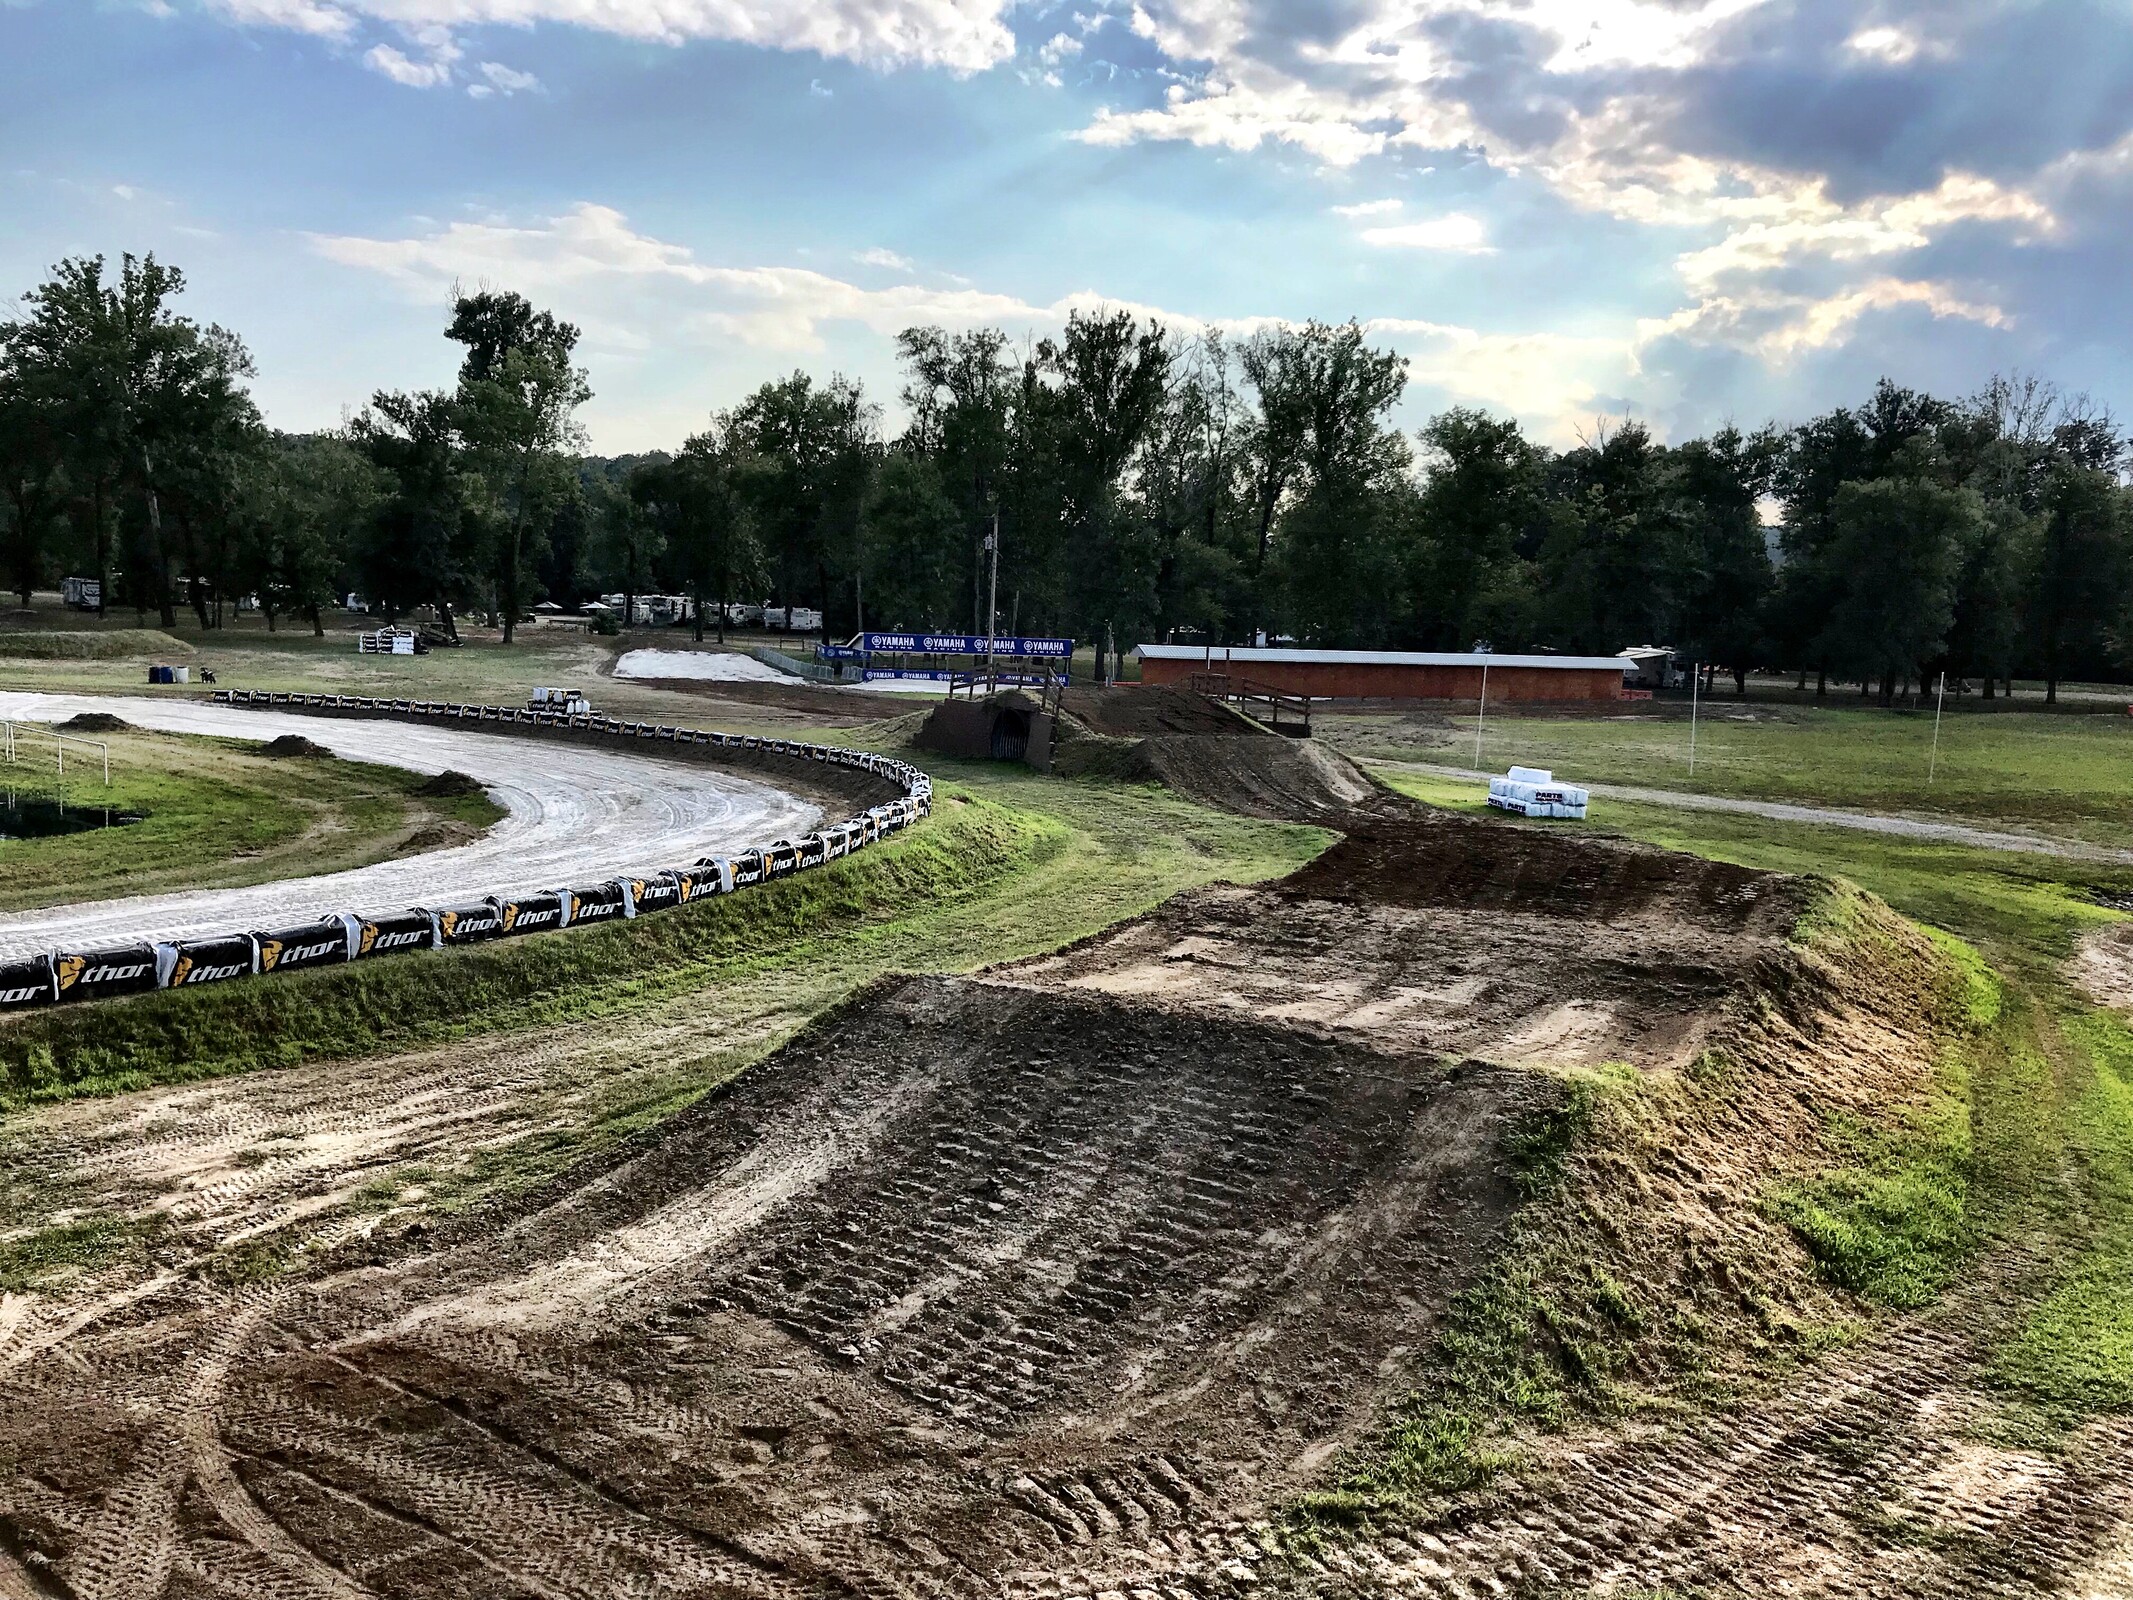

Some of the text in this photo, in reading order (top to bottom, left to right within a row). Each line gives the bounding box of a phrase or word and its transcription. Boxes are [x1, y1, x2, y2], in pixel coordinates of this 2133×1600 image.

[882, 636, 1064, 651] YAMAHA YAMAHA YMAHA YAMAHA
[773, 856, 795, 872] thor
[802, 852, 824, 868] thor
[736, 869, 761, 884] thor
[644, 884, 677, 899] thor
[691, 878, 721, 897] thor
[516, 908, 560, 927] thor
[579, 902, 622, 918] thor
[455, 918, 502, 934] thor
[374, 930, 430, 949] thor
[280, 938, 343, 964] thor
[81, 963, 152, 983] thor
[187, 961, 248, 983] thor
